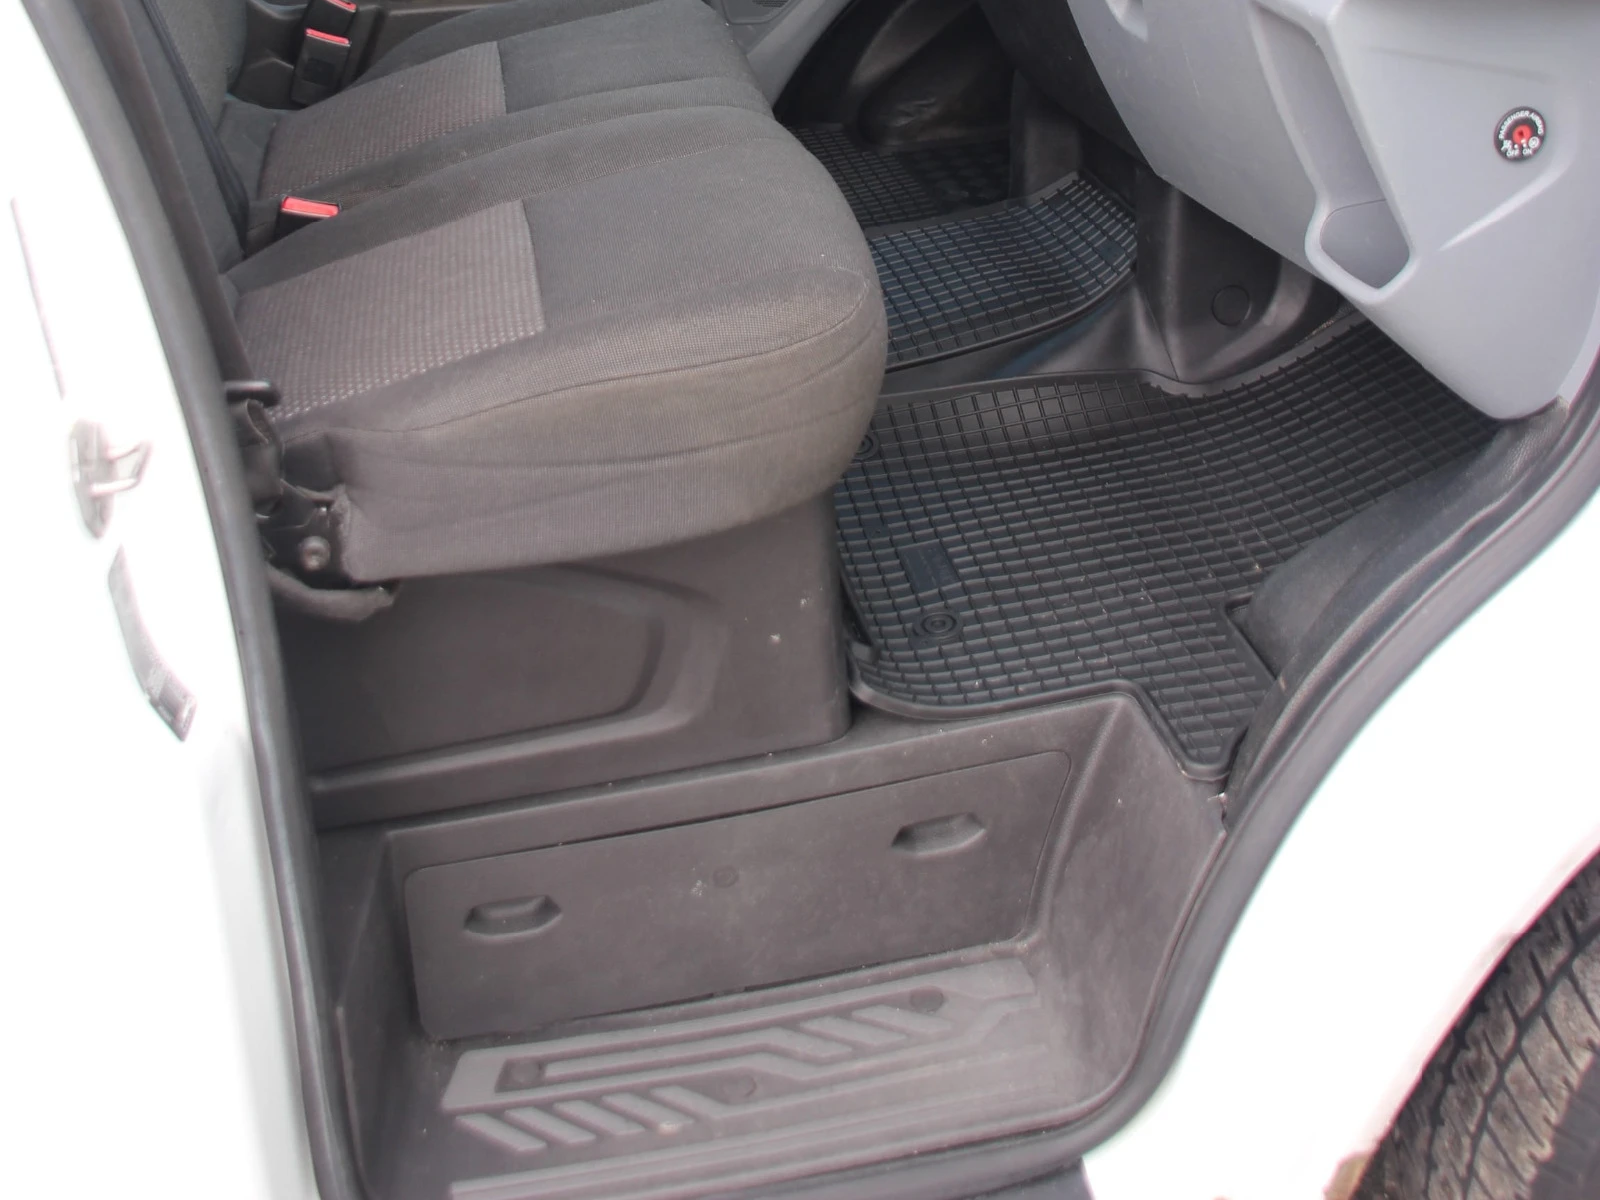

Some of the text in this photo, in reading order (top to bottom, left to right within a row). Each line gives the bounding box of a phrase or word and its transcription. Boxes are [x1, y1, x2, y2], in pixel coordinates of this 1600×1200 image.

[1498, 110, 1545, 140] PASSENGER AIRBAG
[1506, 148, 1533, 158] OFF ON
